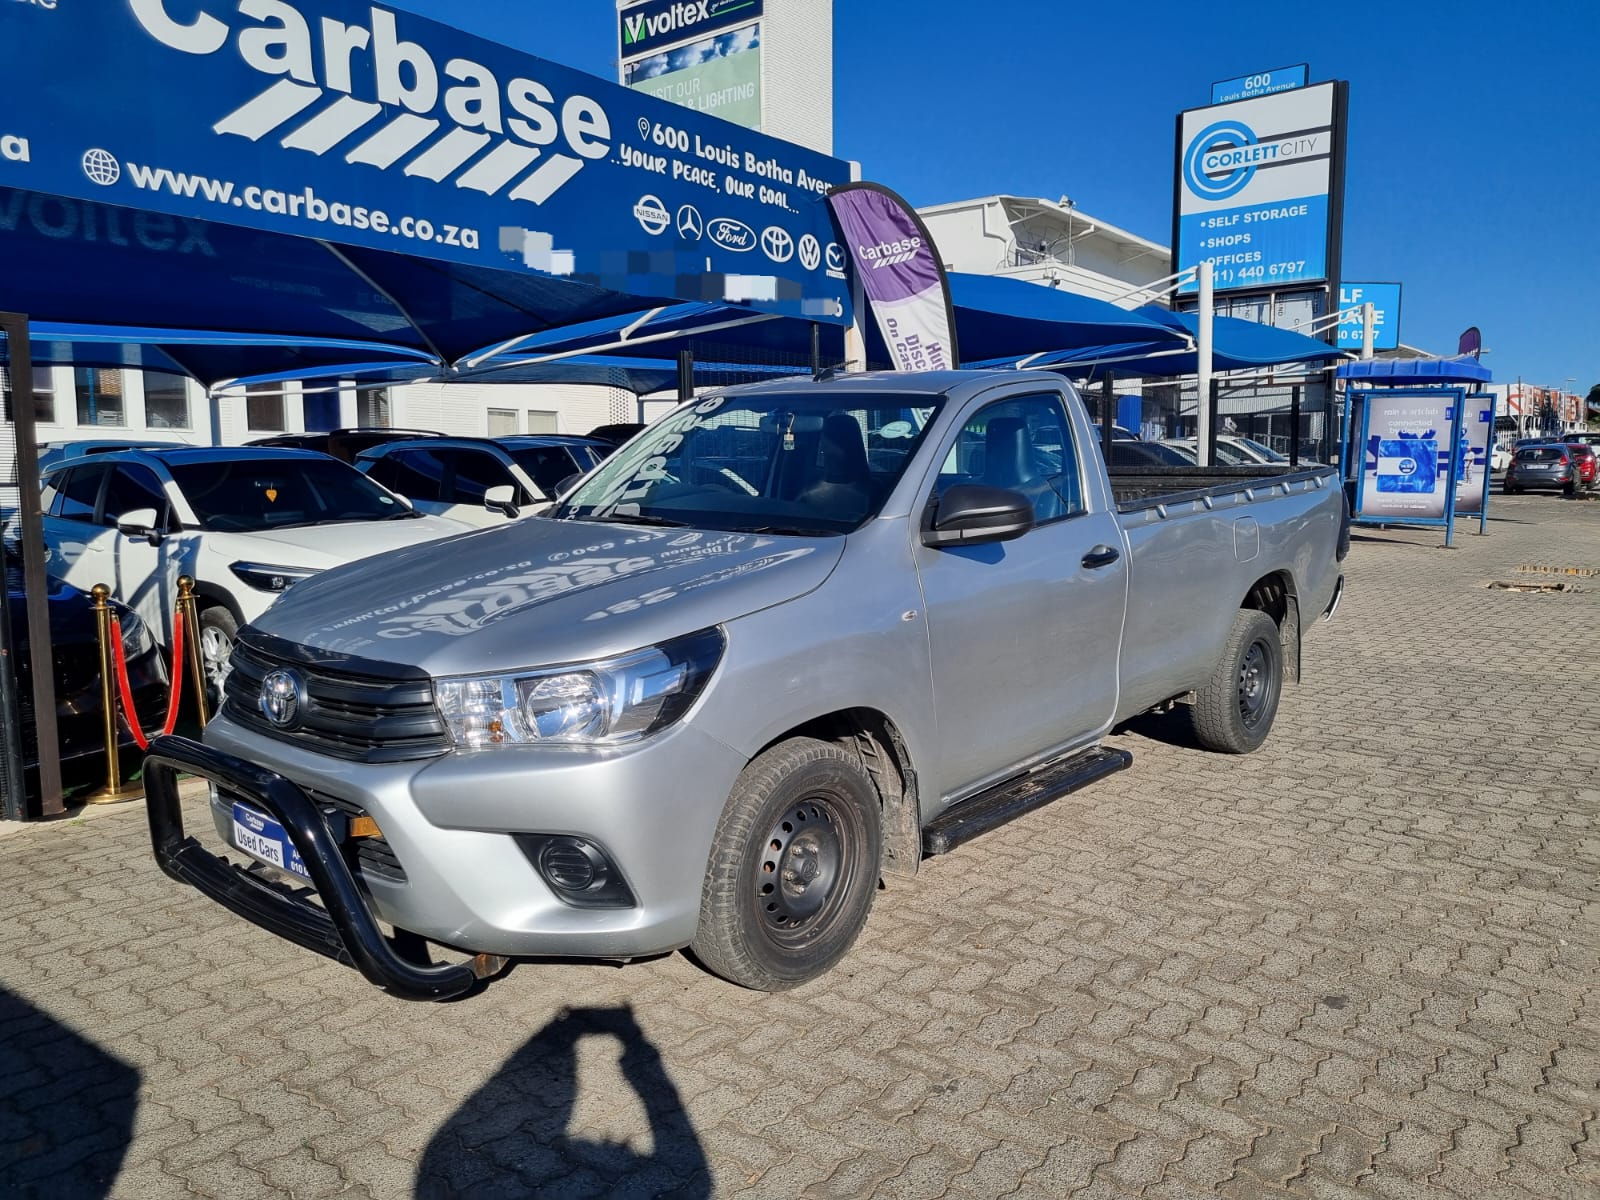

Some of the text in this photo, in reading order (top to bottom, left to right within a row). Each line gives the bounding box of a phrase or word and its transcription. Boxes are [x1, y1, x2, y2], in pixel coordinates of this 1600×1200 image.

[677, 78, 700, 97] OUR
[1220, 81, 1296, 102] Louis Botha Avenue
[1244, 73, 1271, 90] 600
[698, 82, 755, 110] LIGHTING
[652, 123, 689, 153] 600
[695, 135, 740, 169] Louis
[744, 152, 793, 185] Botha
[127, 162, 480, 249] www.carbase.co.za
[635, 207, 669, 222] NISSAN
[1208, 205, 1308, 228] SELF STORAGE
[716, 222, 748, 246] Ford
[1207, 233, 1251, 248] SHOPS
[859, 236, 920, 260] Carbase
[1207, 251, 1262, 266] OFFICES
[1238, 265, 1264, 278] 440
[1269, 260, 1306, 275] 6797
[1340, 288, 1363, 303] LF
[886, 318, 899, 338] On
[237, 827, 258, 851] Used
[259, 838, 280, 863] Cars
